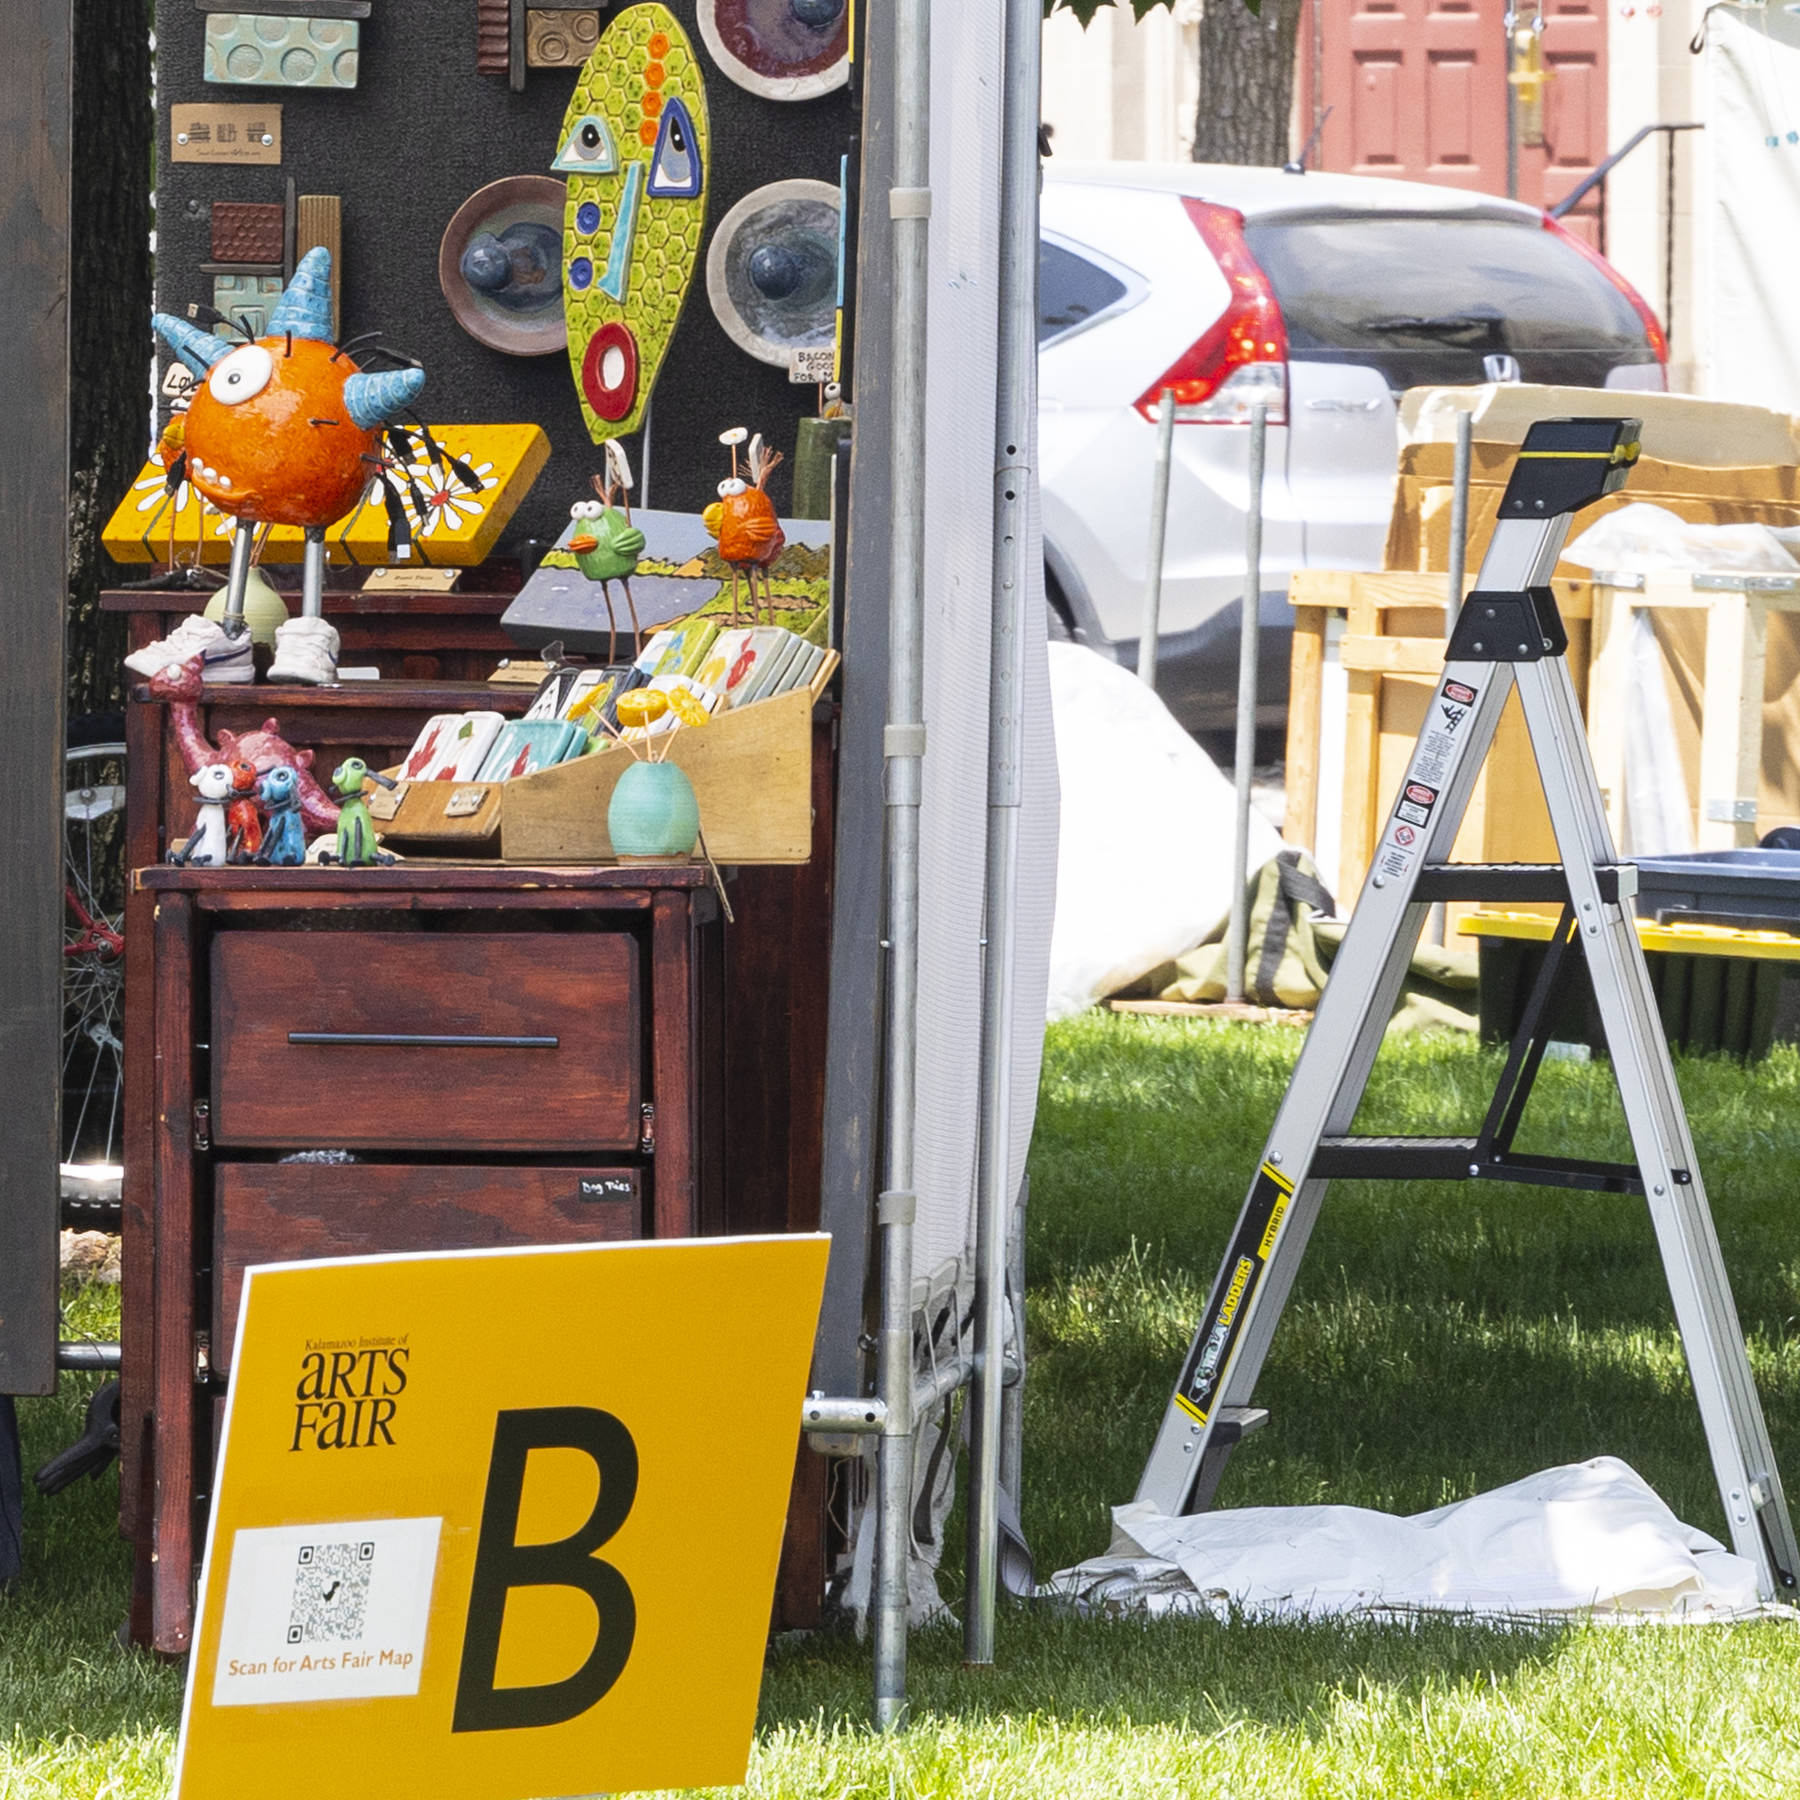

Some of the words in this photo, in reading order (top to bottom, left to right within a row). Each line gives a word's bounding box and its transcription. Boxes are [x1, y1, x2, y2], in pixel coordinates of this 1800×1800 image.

[794, 372, 817, 382] FOR
[1264, 1206, 1285, 1248] HYBRID
[1217, 1258, 1253, 1327] LADDERS
[305, 1338, 357, 1351] Kalamazoo
[359, 1335, 395, 1348] Institute
[398, 1333, 410, 1345] of
[451, 1405, 640, 1734] B
[228, 1659, 267, 1676] Scan
[273, 1656, 296, 1673] for
[299, 1655, 336, 1672] Arts
[341, 1650, 374, 1668] Fair
[379, 1648, 413, 1669] Map
